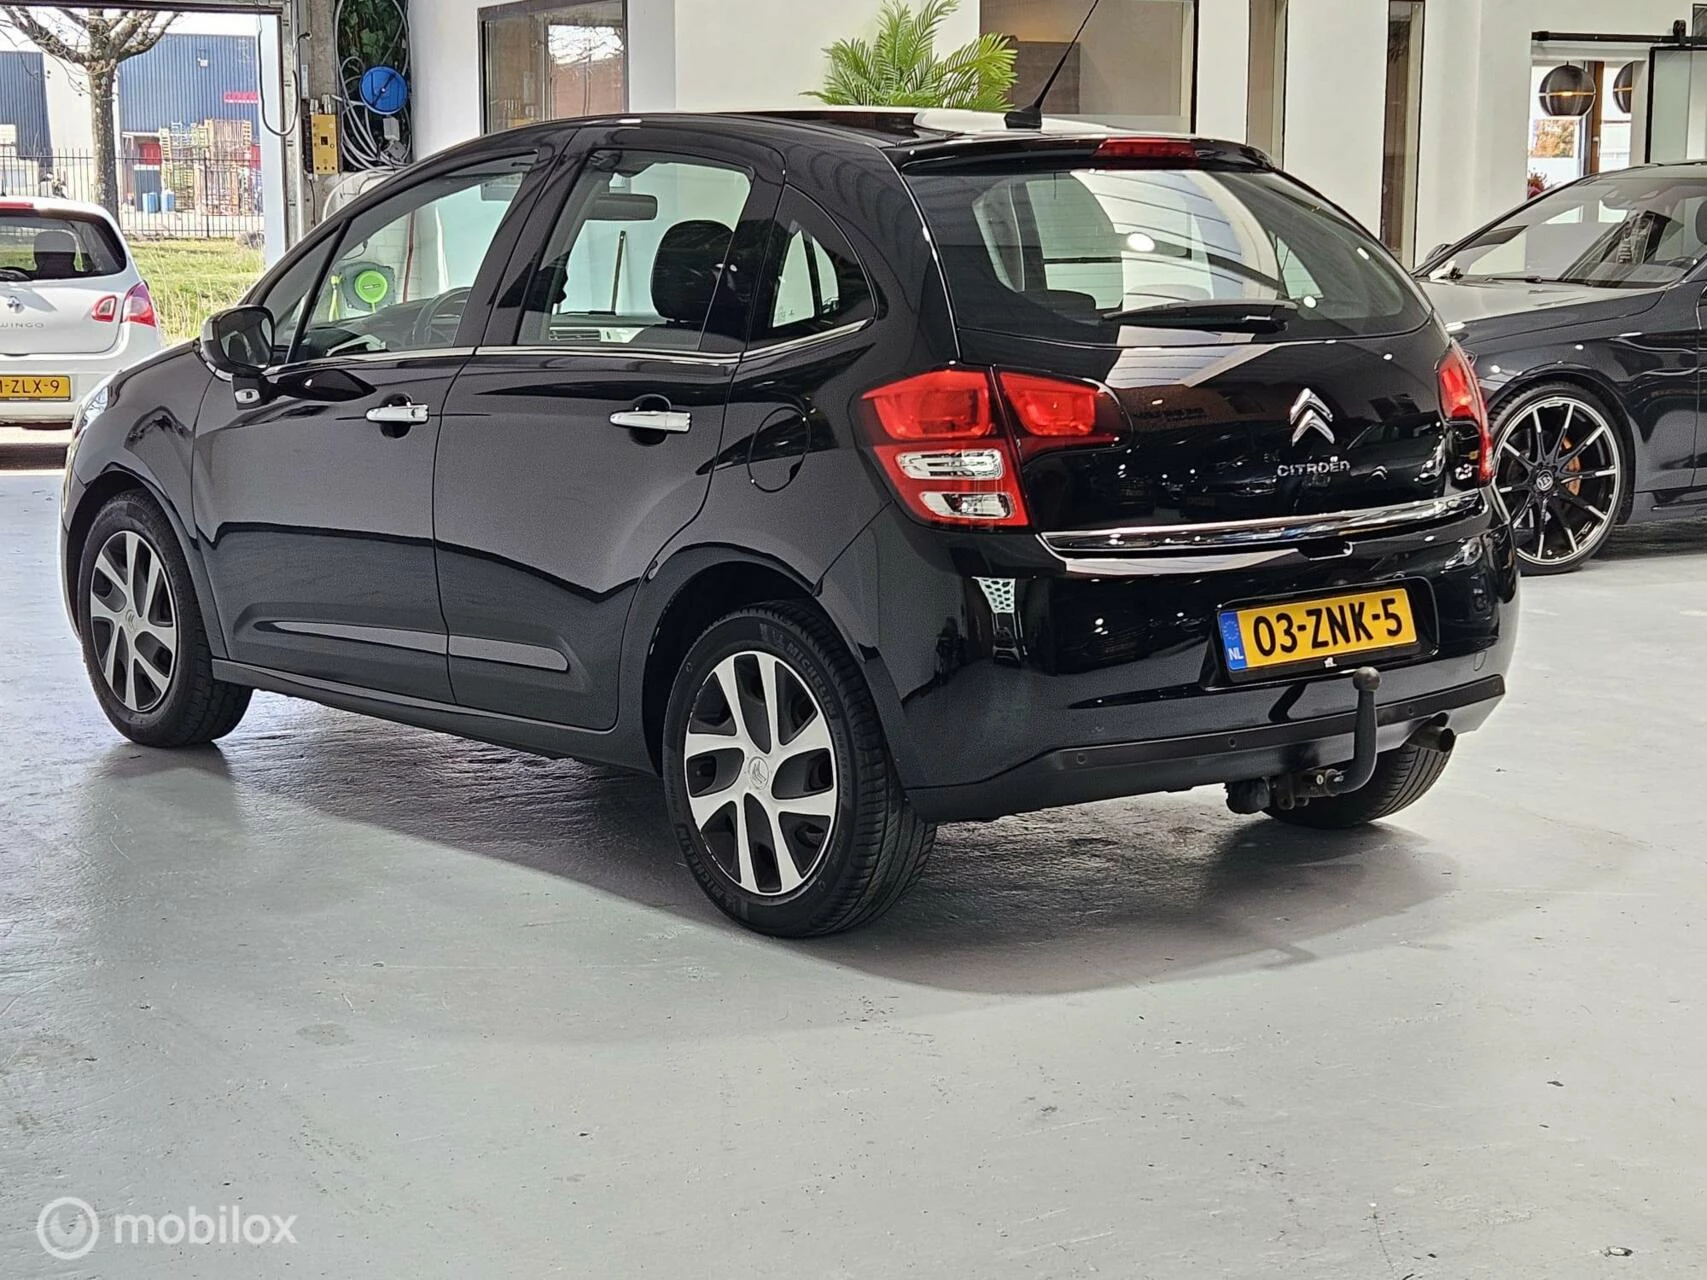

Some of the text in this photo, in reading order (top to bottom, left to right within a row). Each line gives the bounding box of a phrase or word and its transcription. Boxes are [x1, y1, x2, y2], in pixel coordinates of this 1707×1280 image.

[1277, 455, 1351, 478] CITROËN
[1253, 598, 1403, 657] 03-ZNK-5
[1228, 648, 1244, 662] NL
